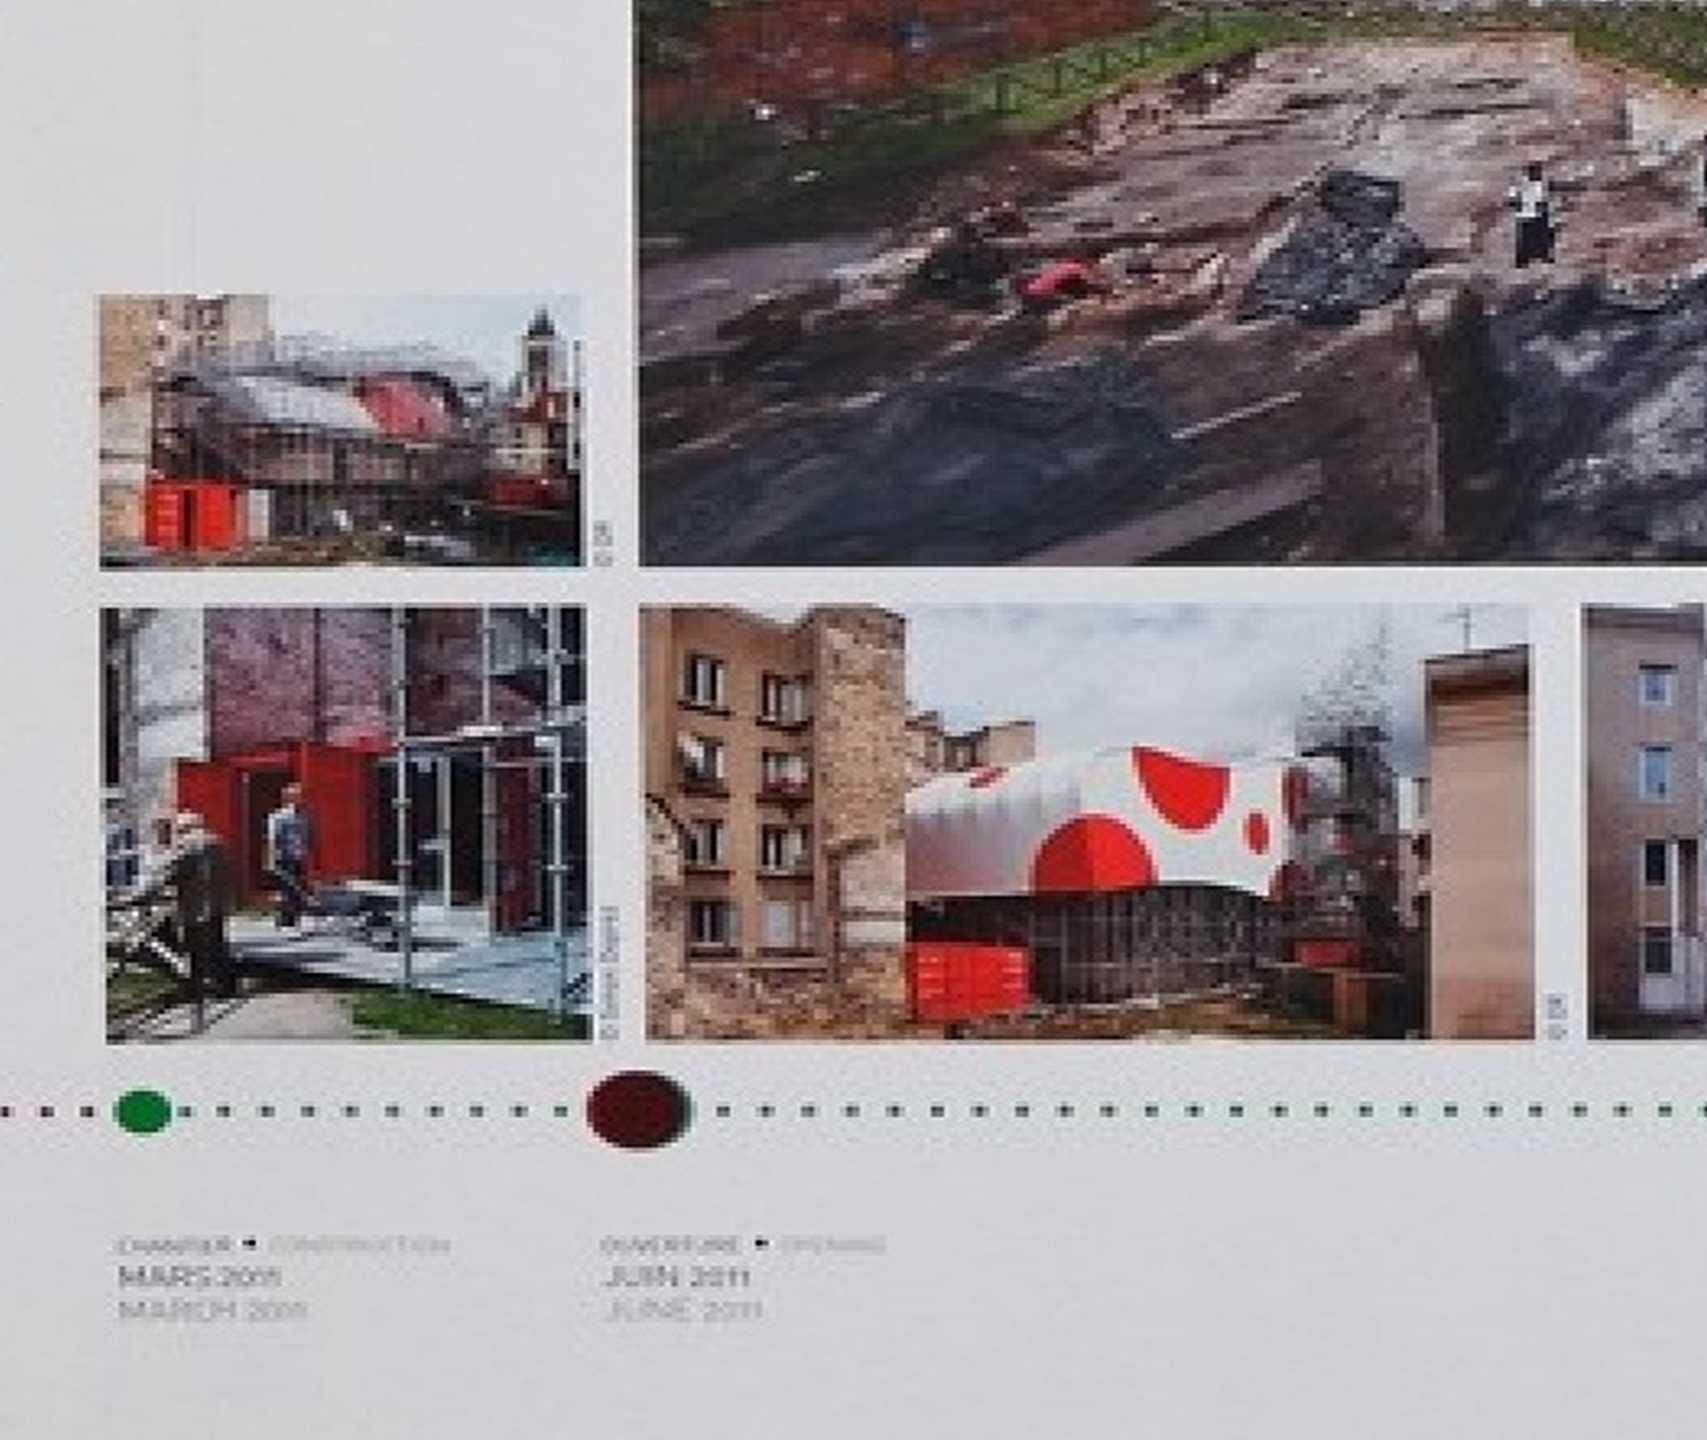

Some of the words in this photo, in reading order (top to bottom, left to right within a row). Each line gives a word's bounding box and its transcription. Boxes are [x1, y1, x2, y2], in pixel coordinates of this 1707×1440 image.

[118, 1265, 212, 1288] MARS
[601, 1265, 679, 1288] JUIN
[690, 1265, 750, 1288] 2011
[118, 1300, 236, 1321] MARCH
[601, 1299, 691, 1322] JUNE
